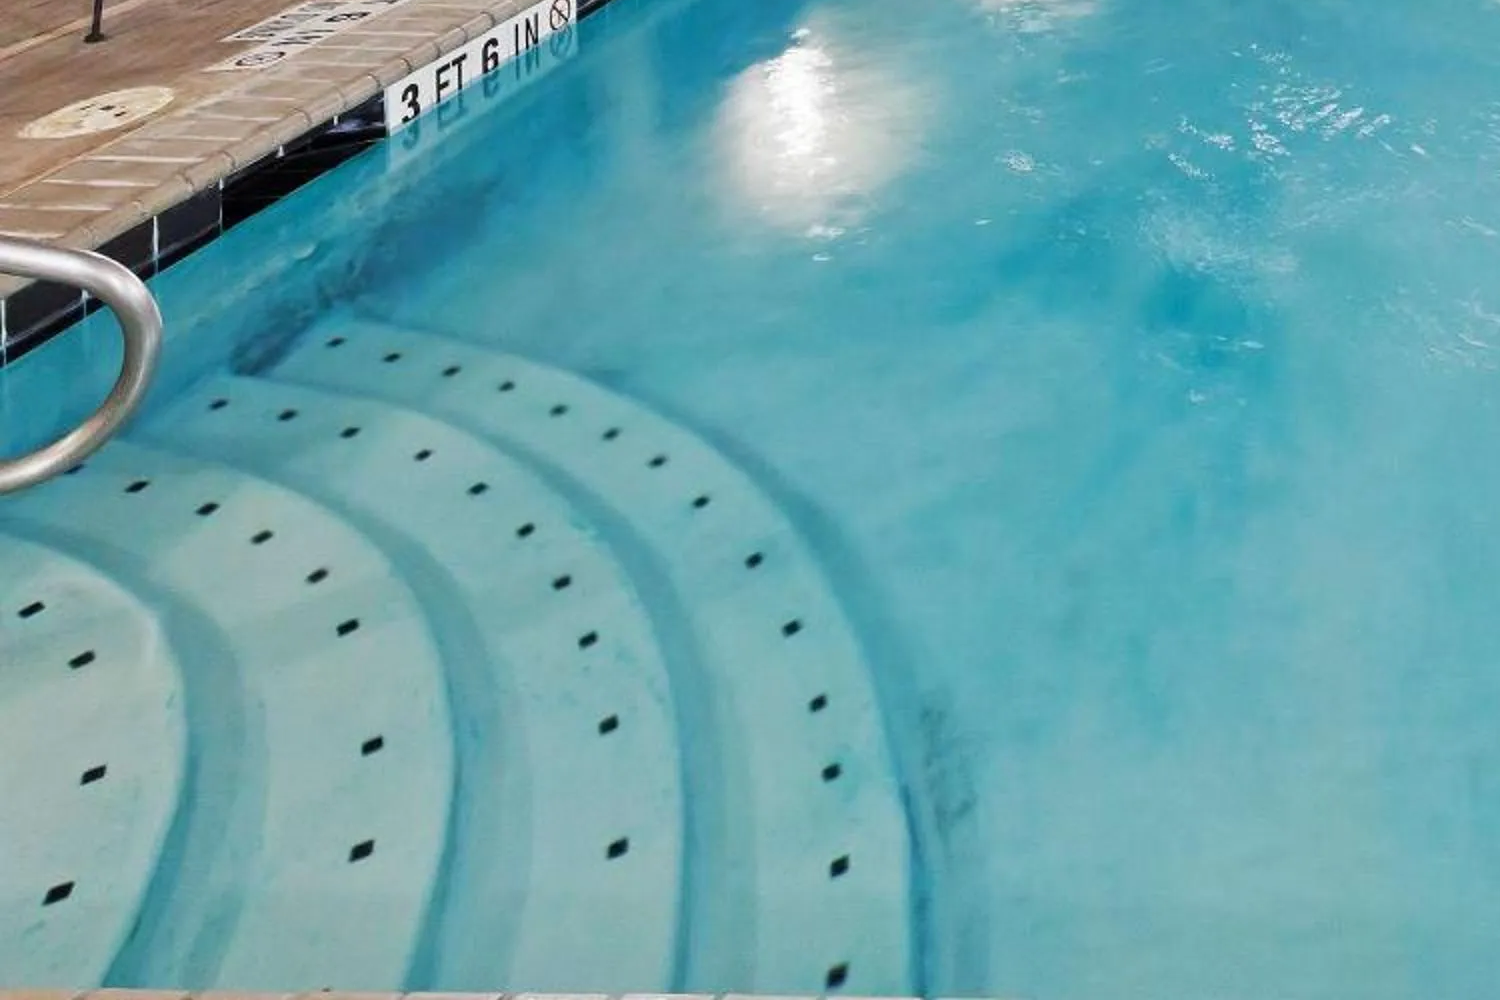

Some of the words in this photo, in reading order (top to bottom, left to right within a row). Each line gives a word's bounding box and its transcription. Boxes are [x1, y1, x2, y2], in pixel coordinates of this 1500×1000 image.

[401, 83, 422, 125] 3
[435, 53, 468, 104] FT
[481, 37, 500, 75] 6
[513, 12, 539, 57] IN
